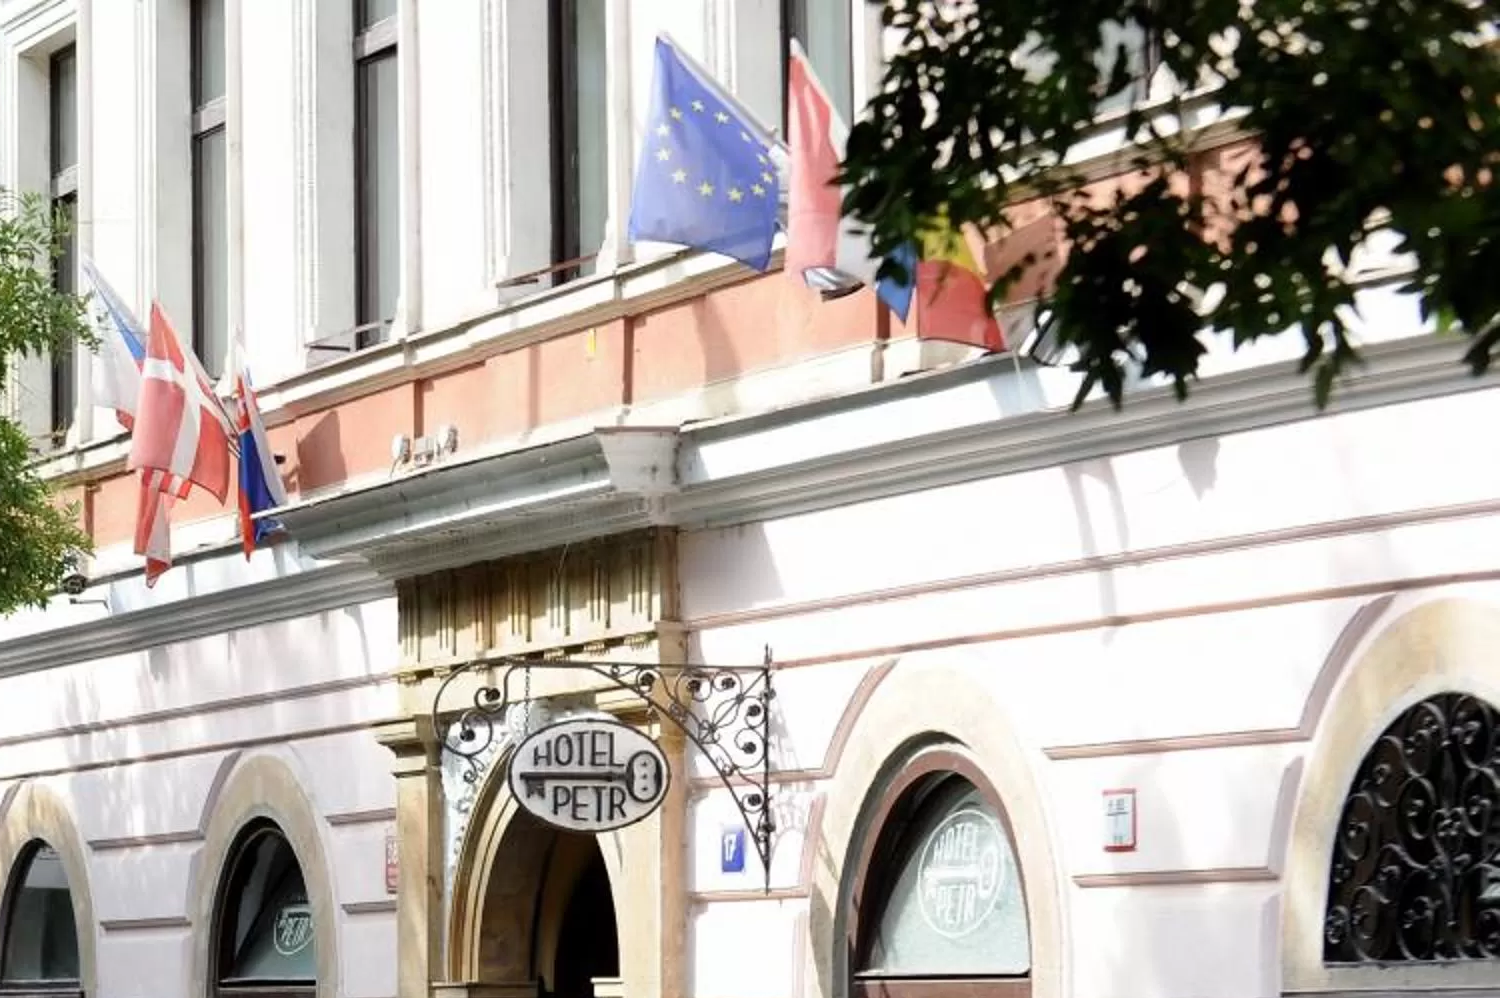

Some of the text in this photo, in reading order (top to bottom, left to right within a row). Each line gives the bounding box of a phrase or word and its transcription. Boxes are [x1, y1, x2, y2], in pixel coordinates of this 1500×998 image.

[533, 730, 625, 766] HOTEL
[552, 785, 627, 822] PETR
[933, 822, 979, 861] HOTEL
[936, 883, 977, 926] PETR
